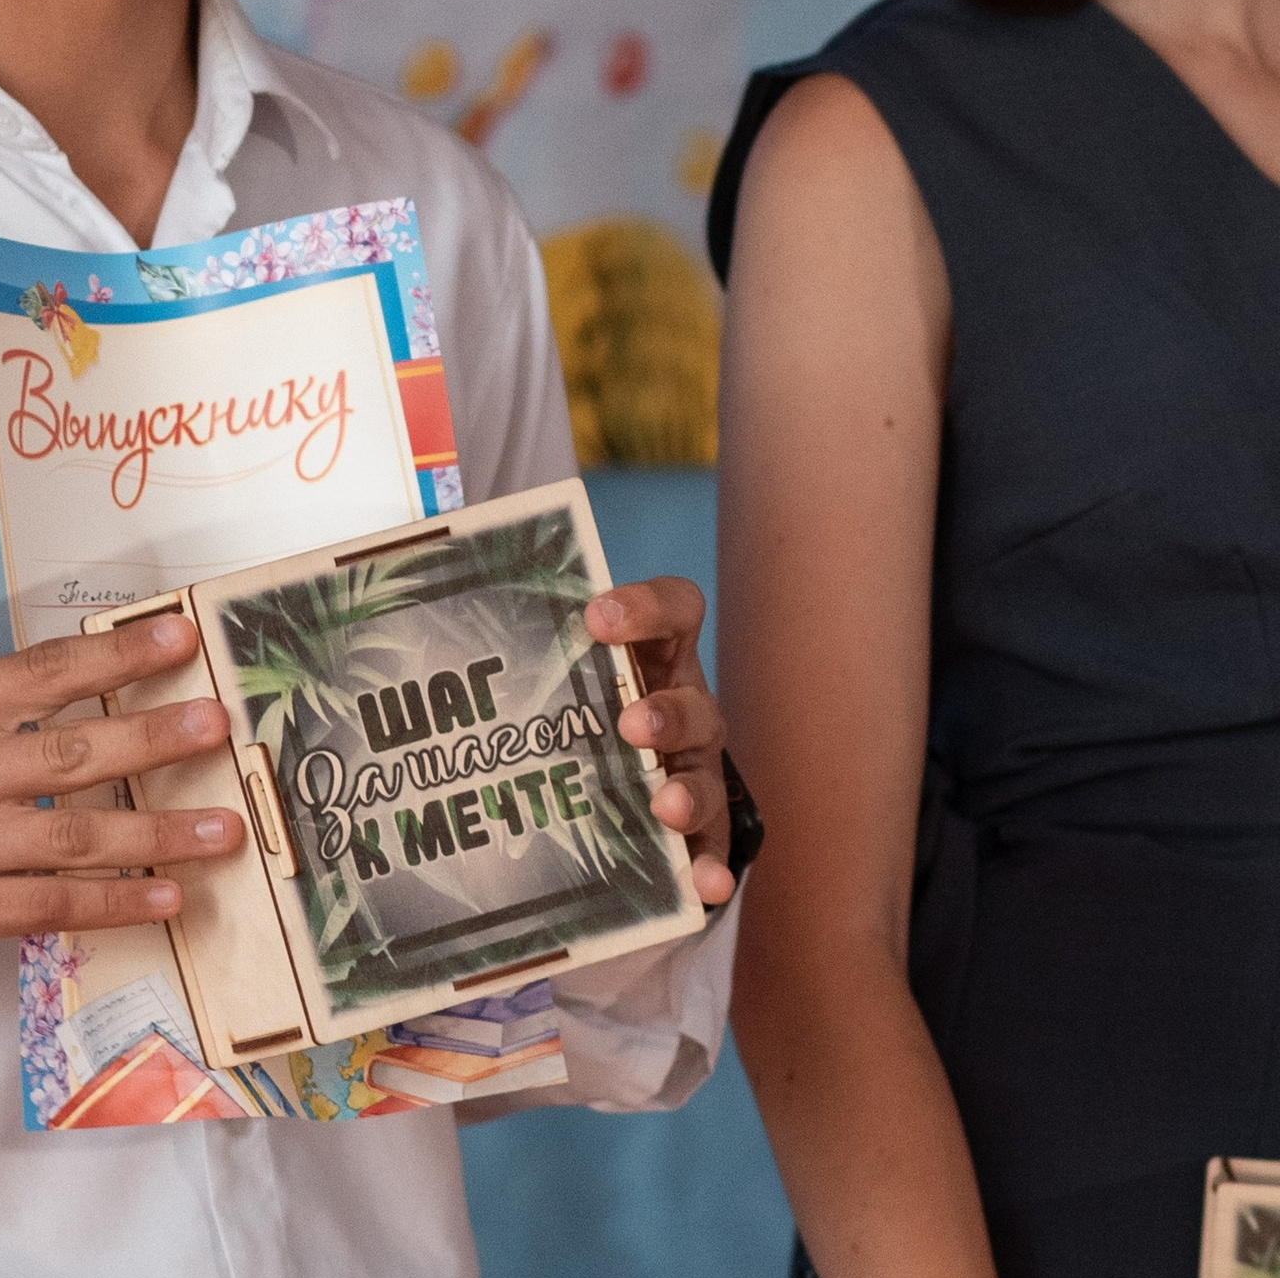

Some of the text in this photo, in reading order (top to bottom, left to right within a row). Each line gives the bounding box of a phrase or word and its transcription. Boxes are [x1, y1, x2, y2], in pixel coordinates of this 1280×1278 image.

[1, 349, 354, 510] Выпускнику
[357, 655, 505, 755] ШАГ
[296, 703, 605, 861] За шагом
[350, 759, 593, 882] К МЕЧТЕ
